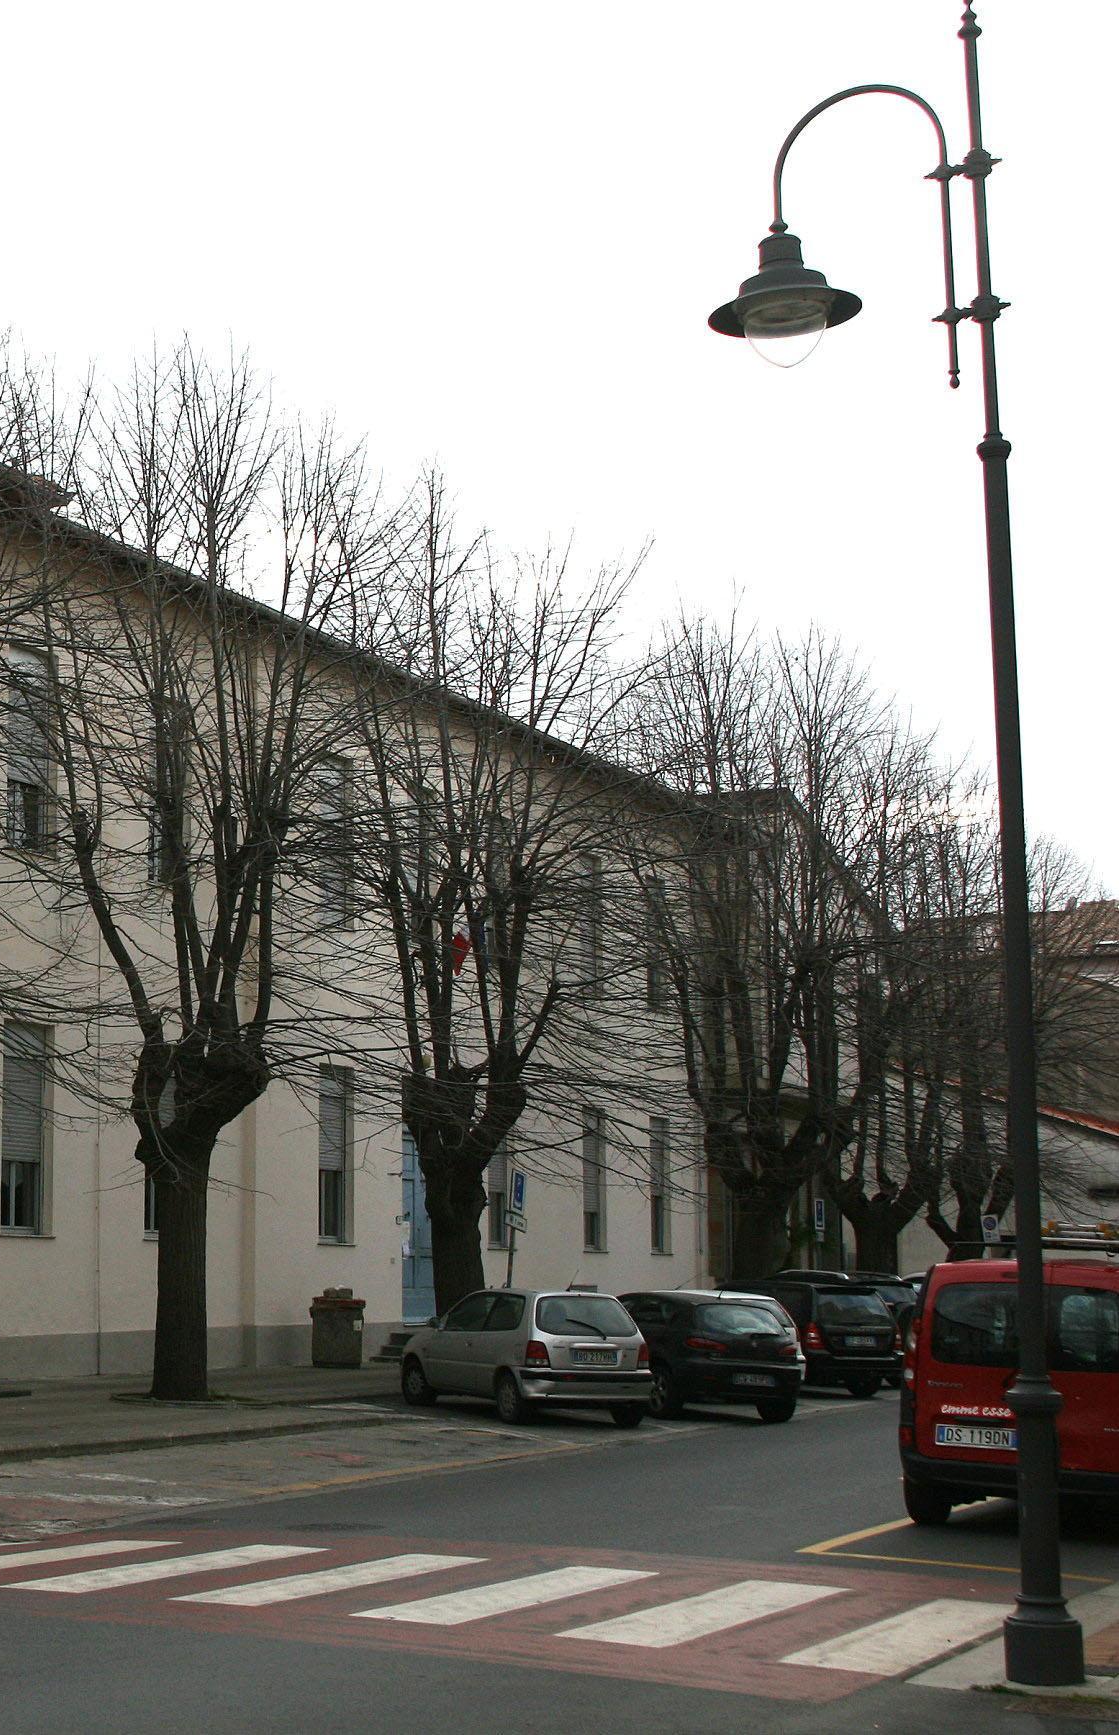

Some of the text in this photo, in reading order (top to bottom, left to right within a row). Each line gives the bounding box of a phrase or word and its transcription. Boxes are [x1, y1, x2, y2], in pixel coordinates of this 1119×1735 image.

[941, 1404, 1012, 1417] emme esse
[946, 1428, 1010, 1446] DS 119DN
